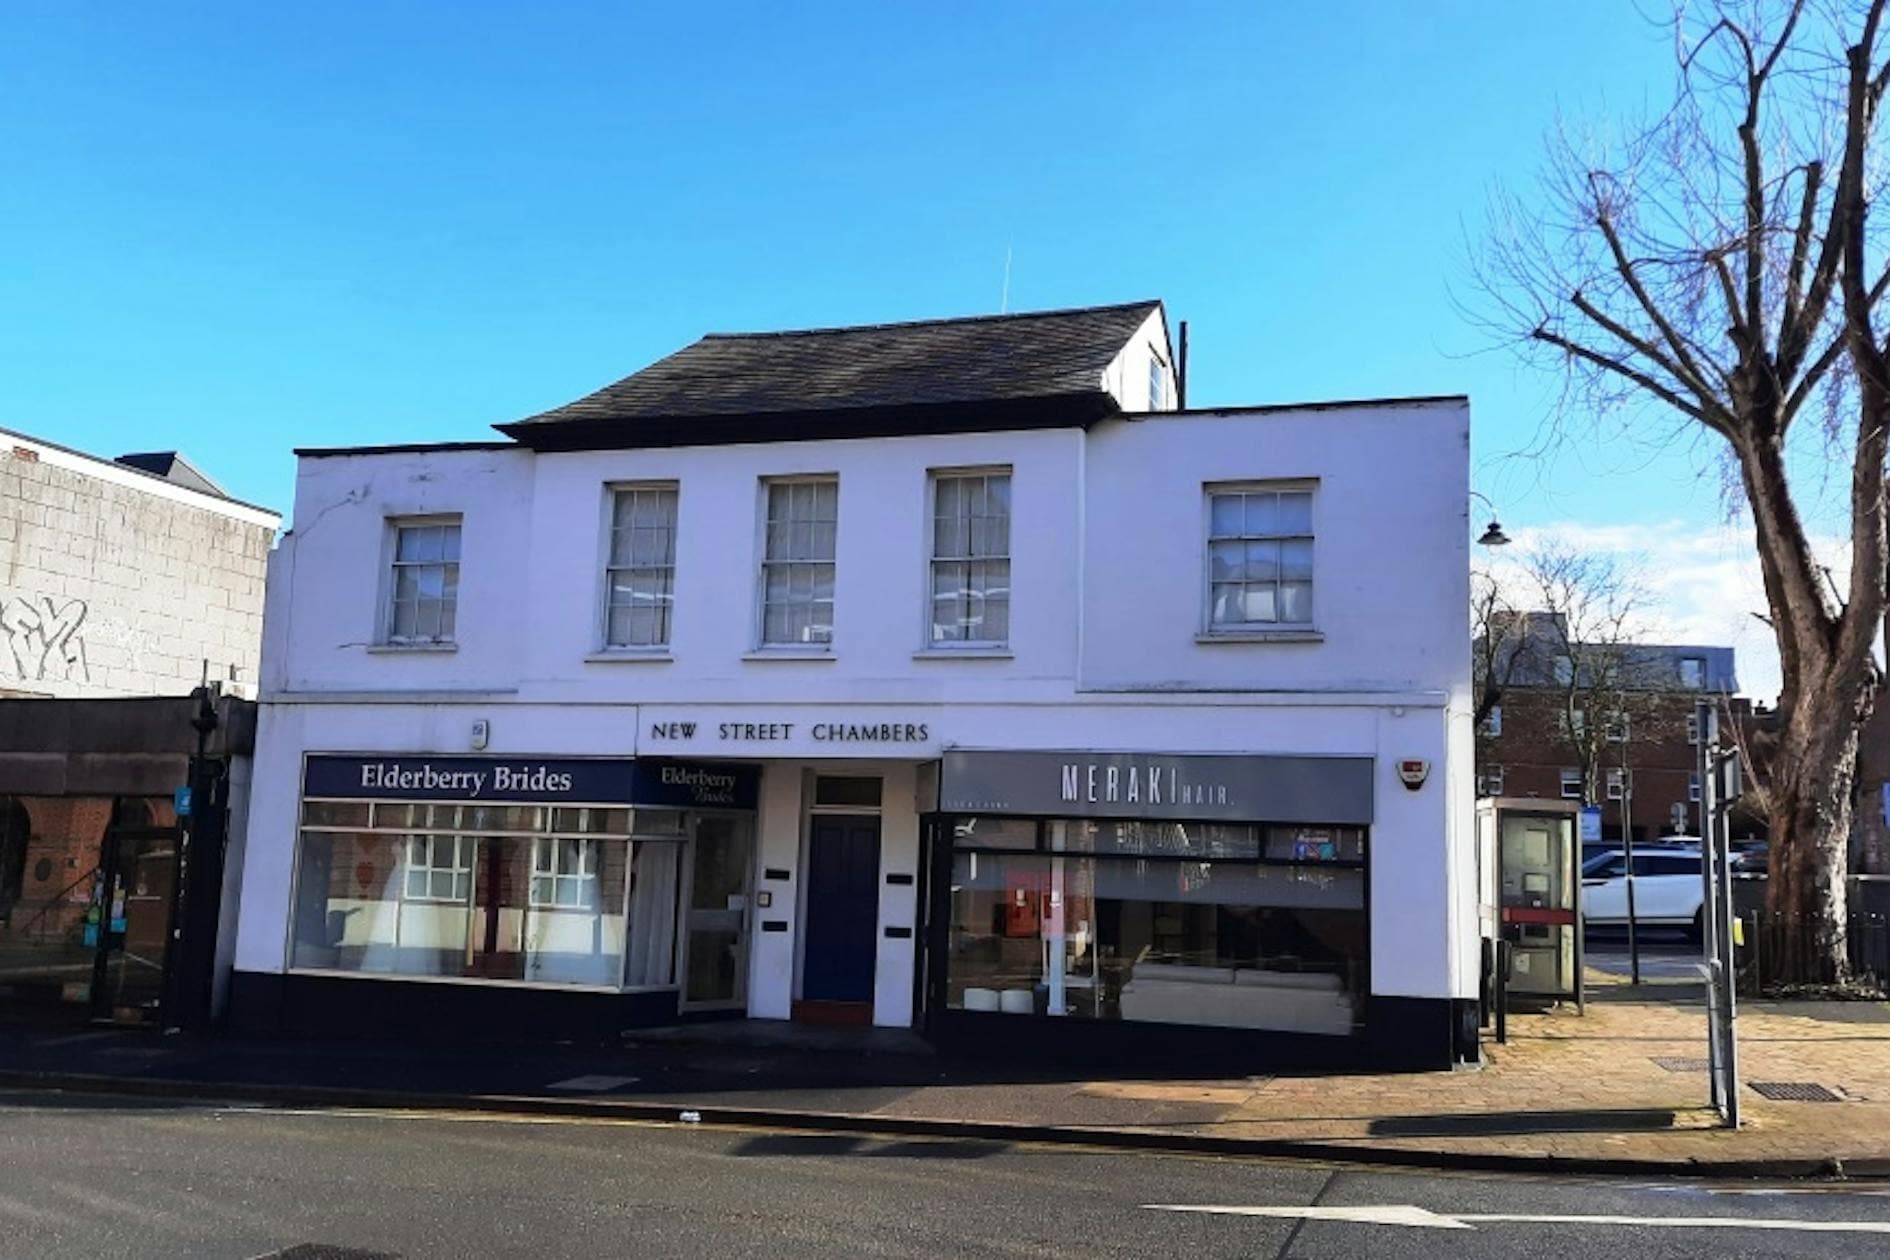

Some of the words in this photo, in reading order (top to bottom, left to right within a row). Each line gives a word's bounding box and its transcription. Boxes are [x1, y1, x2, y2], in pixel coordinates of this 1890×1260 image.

[652, 723, 697, 739] NEW
[719, 724, 794, 740] STREET
[812, 724, 929, 741] CHAMBERS
[361, 763, 486, 797] Elderberry
[493, 766, 573, 791] Brides
[661, 767, 736, 791] Elderberry
[1061, 766, 1176, 803] MERAKI
